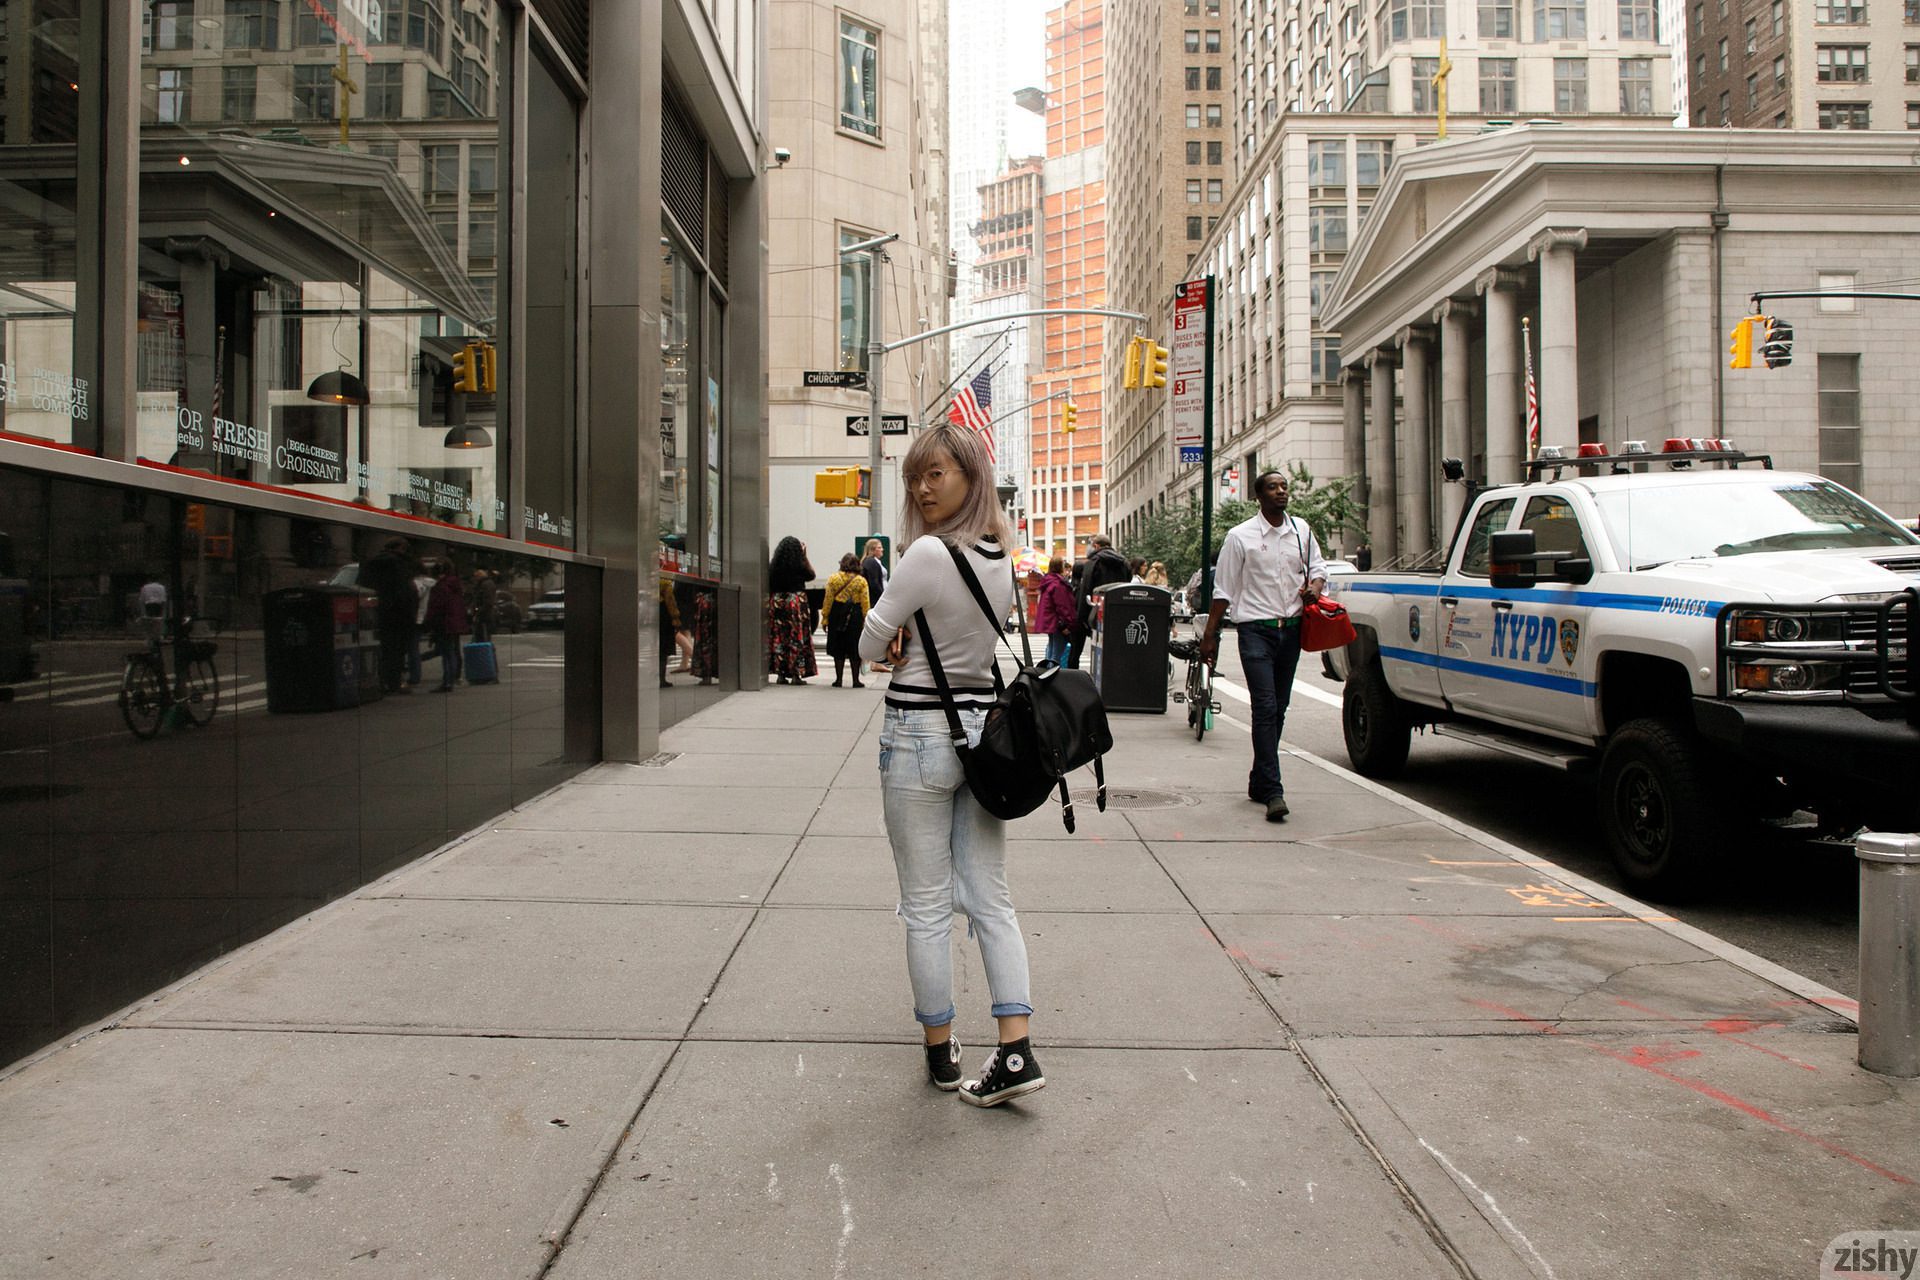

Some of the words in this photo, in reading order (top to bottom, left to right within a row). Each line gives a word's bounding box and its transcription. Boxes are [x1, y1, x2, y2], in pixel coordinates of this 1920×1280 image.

[1177, 316, 1184, 329] 3
[1176, 342, 1193, 350] PERMIT
[76, 377, 88, 391] UP
[808, 374, 840, 384] CHURCH
[1177, 381, 1183, 394] 3
[32, 378, 88, 407] LUNCH
[32, 396, 88, 421] COMBOS
[212, 416, 268, 451] FRESH
[856, 422, 868, 431] ON
[882, 421, 900, 430] WAY
[212, 441, 269, 464] SANDWICHES
[276, 446, 341, 482] CROISSANT
[408, 486, 431, 504] PANNA
[434, 480, 460, 499] CLASSIC
[434, 494, 460, 511] CAESAR
[1661, 597, 1706, 616] POLICE
[1491, 612, 1557, 665] NYPD
